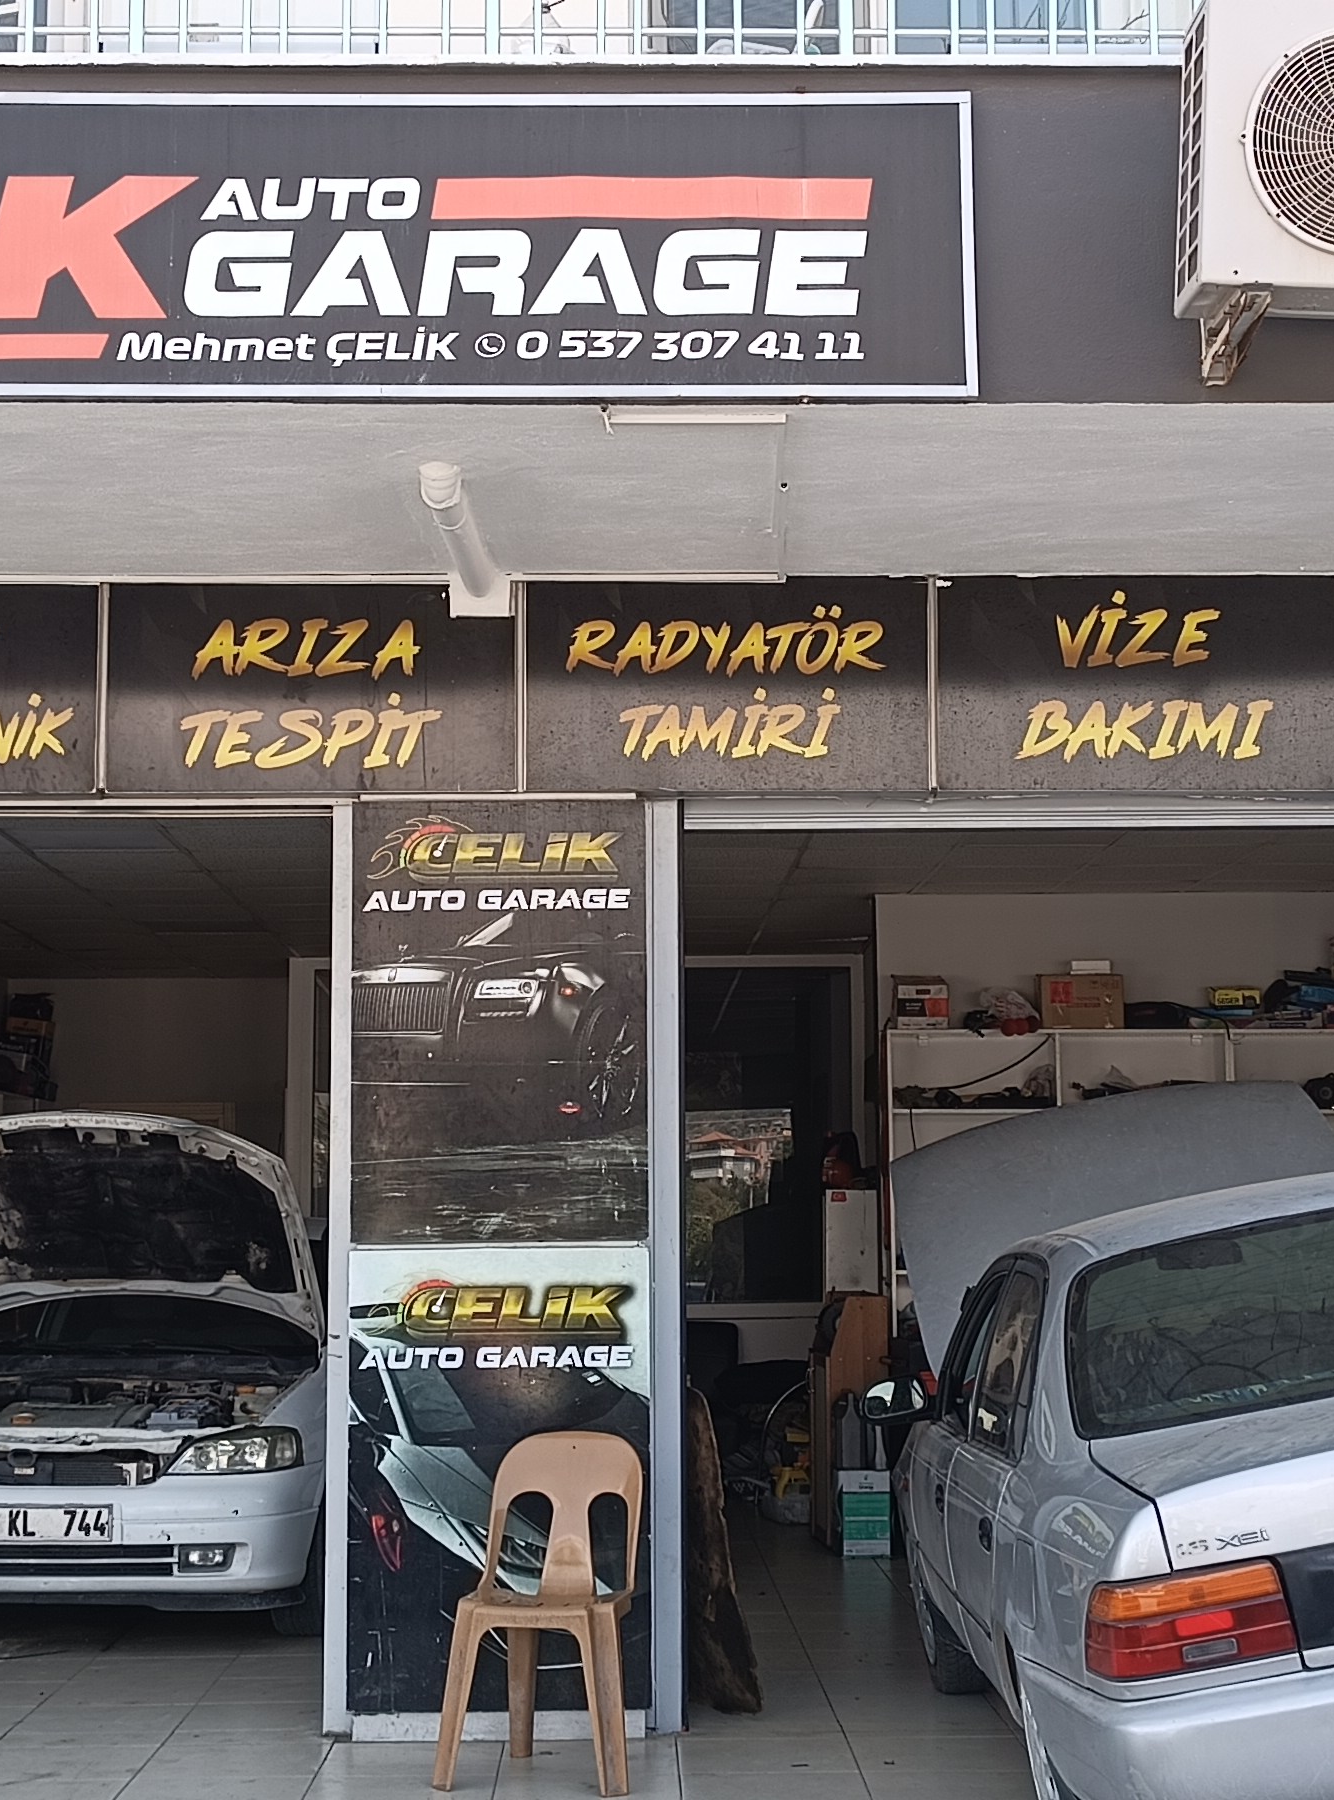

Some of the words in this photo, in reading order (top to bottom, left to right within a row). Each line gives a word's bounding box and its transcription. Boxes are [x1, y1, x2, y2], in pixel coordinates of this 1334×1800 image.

[200, 176, 422, 222] AUTO
[183, 227, 869, 319] GARAGE
[116, 330, 317, 362] Mehmet
[325, 326, 460, 368] ÇELİK
[515, 330, 550, 361] 0
[557, 330, 643, 361] 537
[653, 330, 740, 362] 307
[747, 330, 804, 361] 41
[814, 330, 867, 361] 11
[190, 617, 422, 681] ARIZA
[564, 604, 889, 678] RADYATÖR
[1055, 588, 1223, 669] VİZE
[178, 691, 444, 770] TESPİT
[618, 686, 842, 760] TAMİRİ
[1014, 698, 1274, 763] BAKIMI
[362, 888, 466, 912] AUTO
[476, 887, 632, 911] GARAGE
[357, 1345, 465, 1370] AUTO
[474, 1344, 634, 1369] GARAGE
[8, 1509, 37, 1538] KL
[63, 1509, 109, 1538] 744
